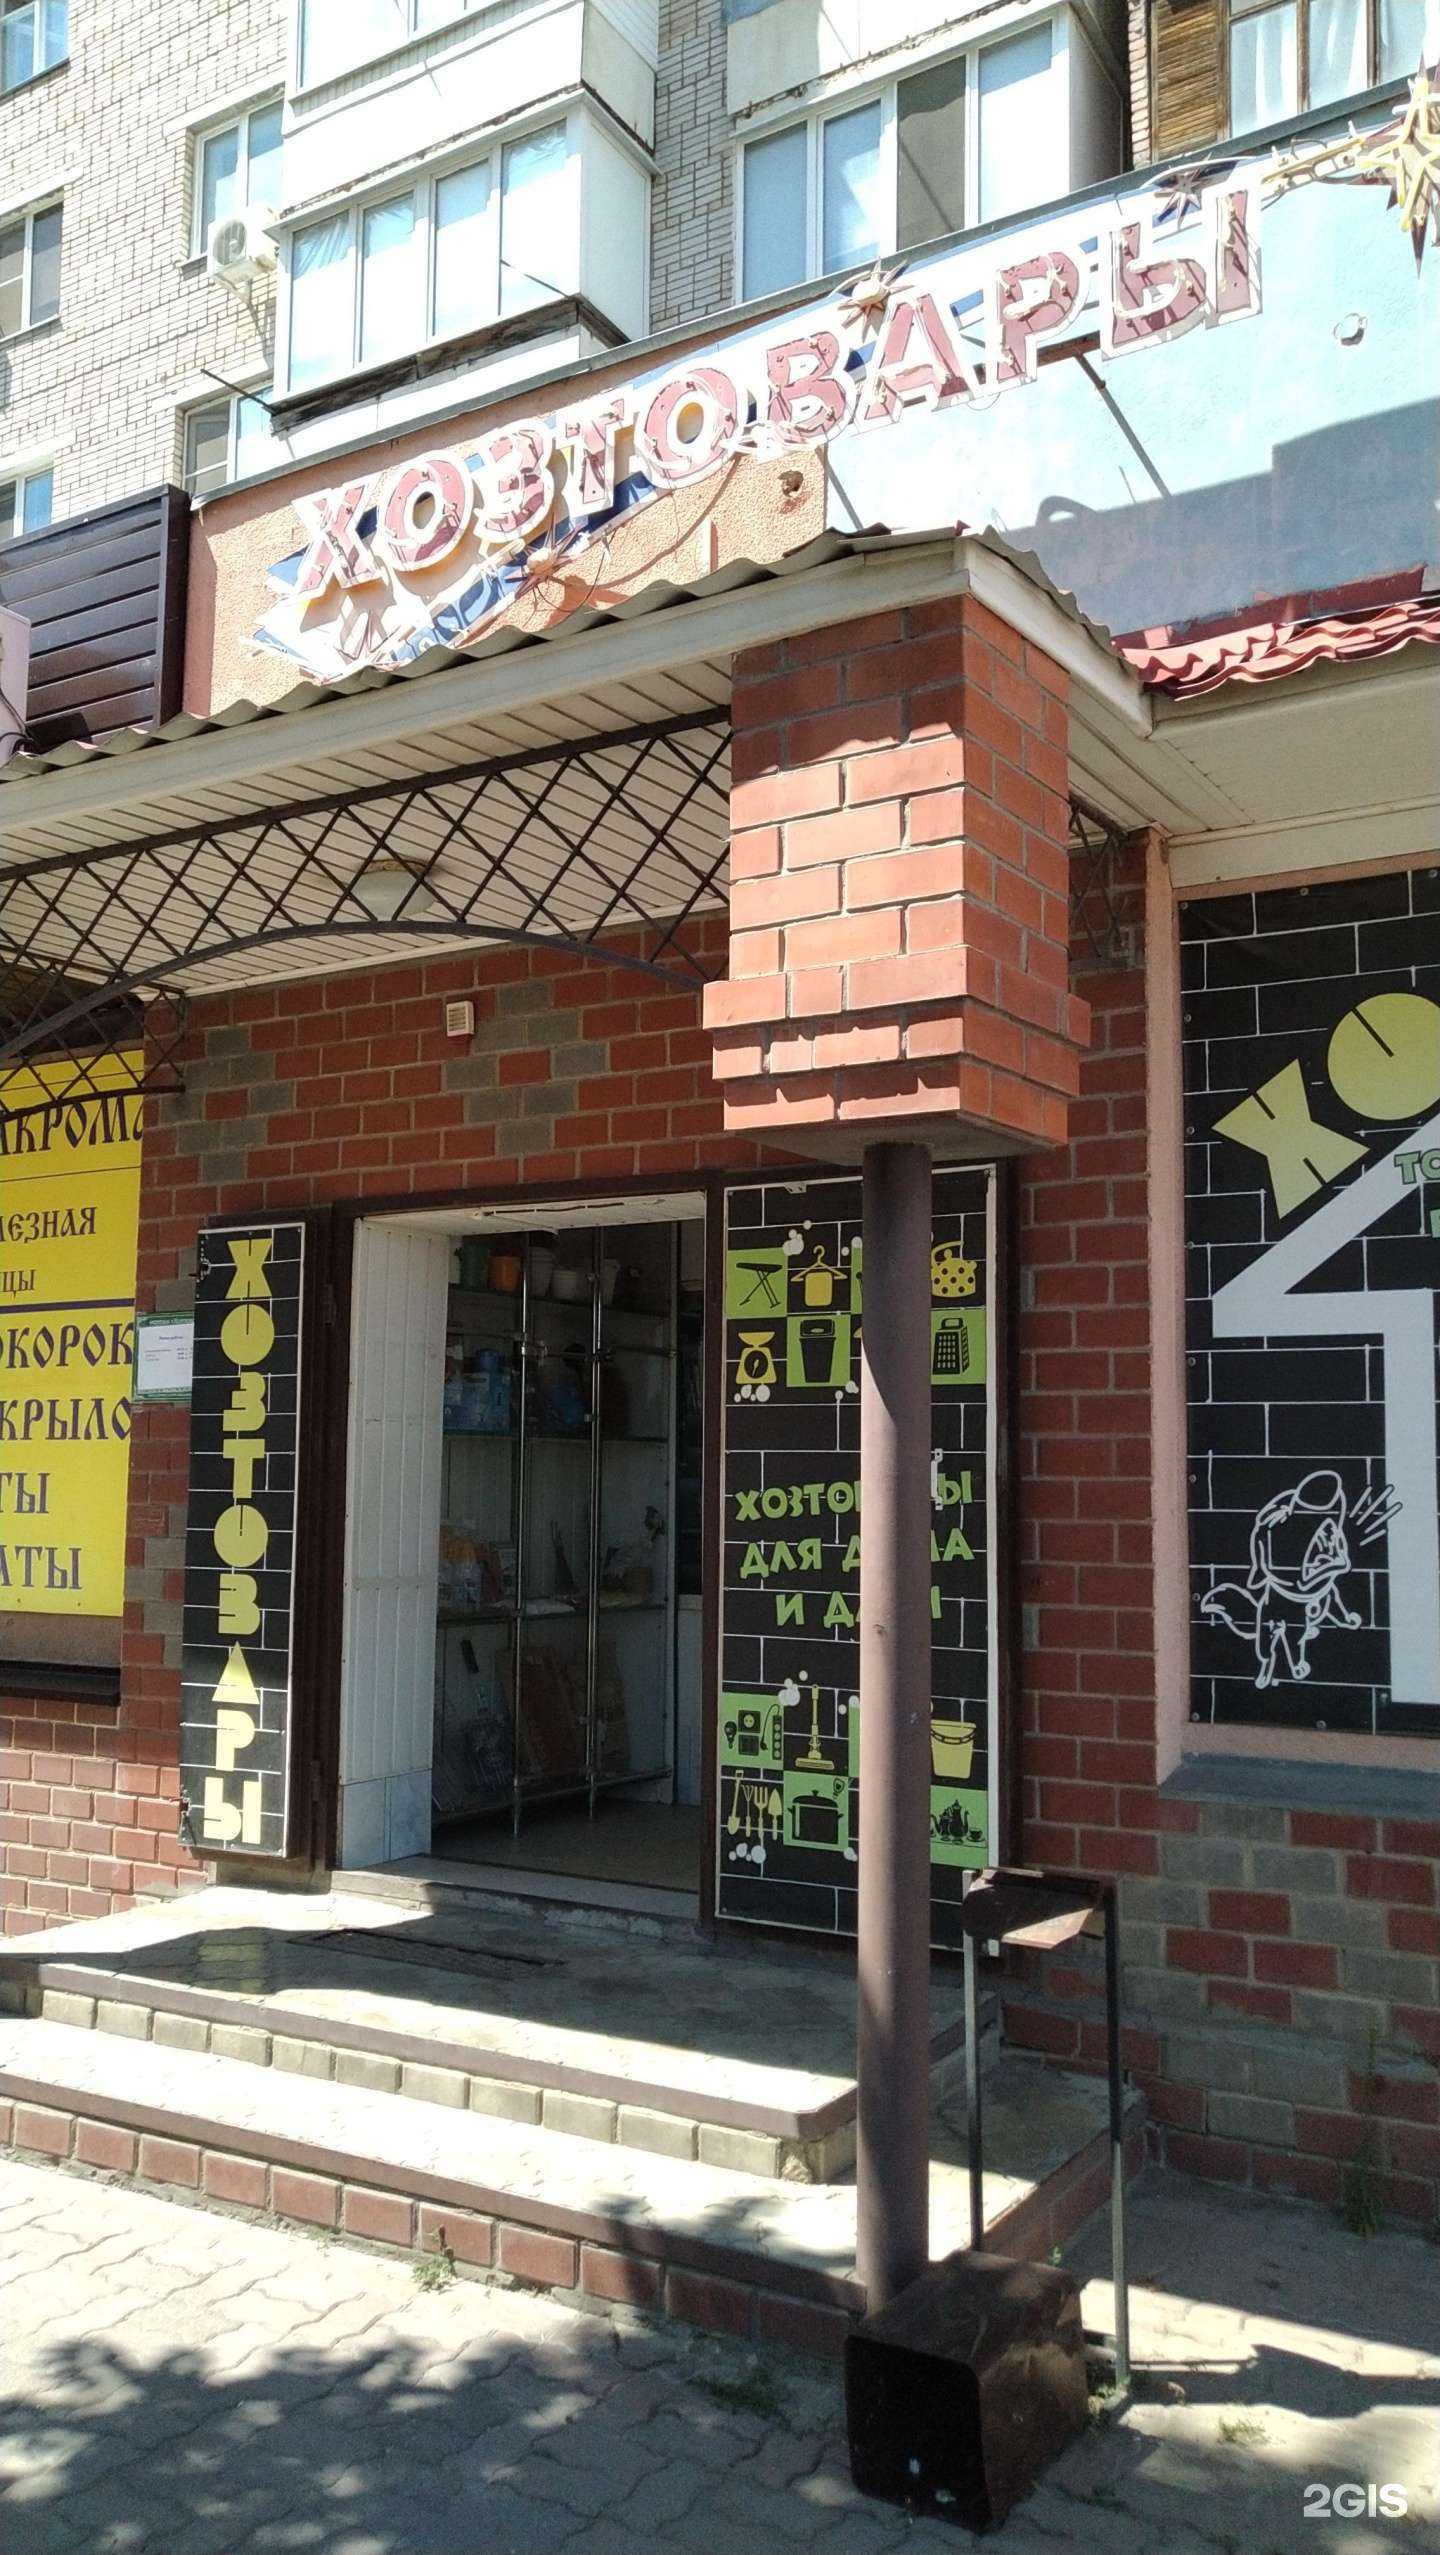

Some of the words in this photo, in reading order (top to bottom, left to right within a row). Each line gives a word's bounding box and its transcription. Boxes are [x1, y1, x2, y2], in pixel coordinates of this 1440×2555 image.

[291, 185, 1262, 602] ХОЗТОВАРЫ
[0, 1207, 97, 1244] ЕЗНАЯ
[0, 1323, 133, 1369] КОРОК
[735, 1470, 973, 1521] ХОЗТОЫ
[203, 1238, 275, 1845] ХОЗТОВАРЫ
[740, 1537, 822, 1579] ДЛЯ
[775, 1593, 805, 1627] И
